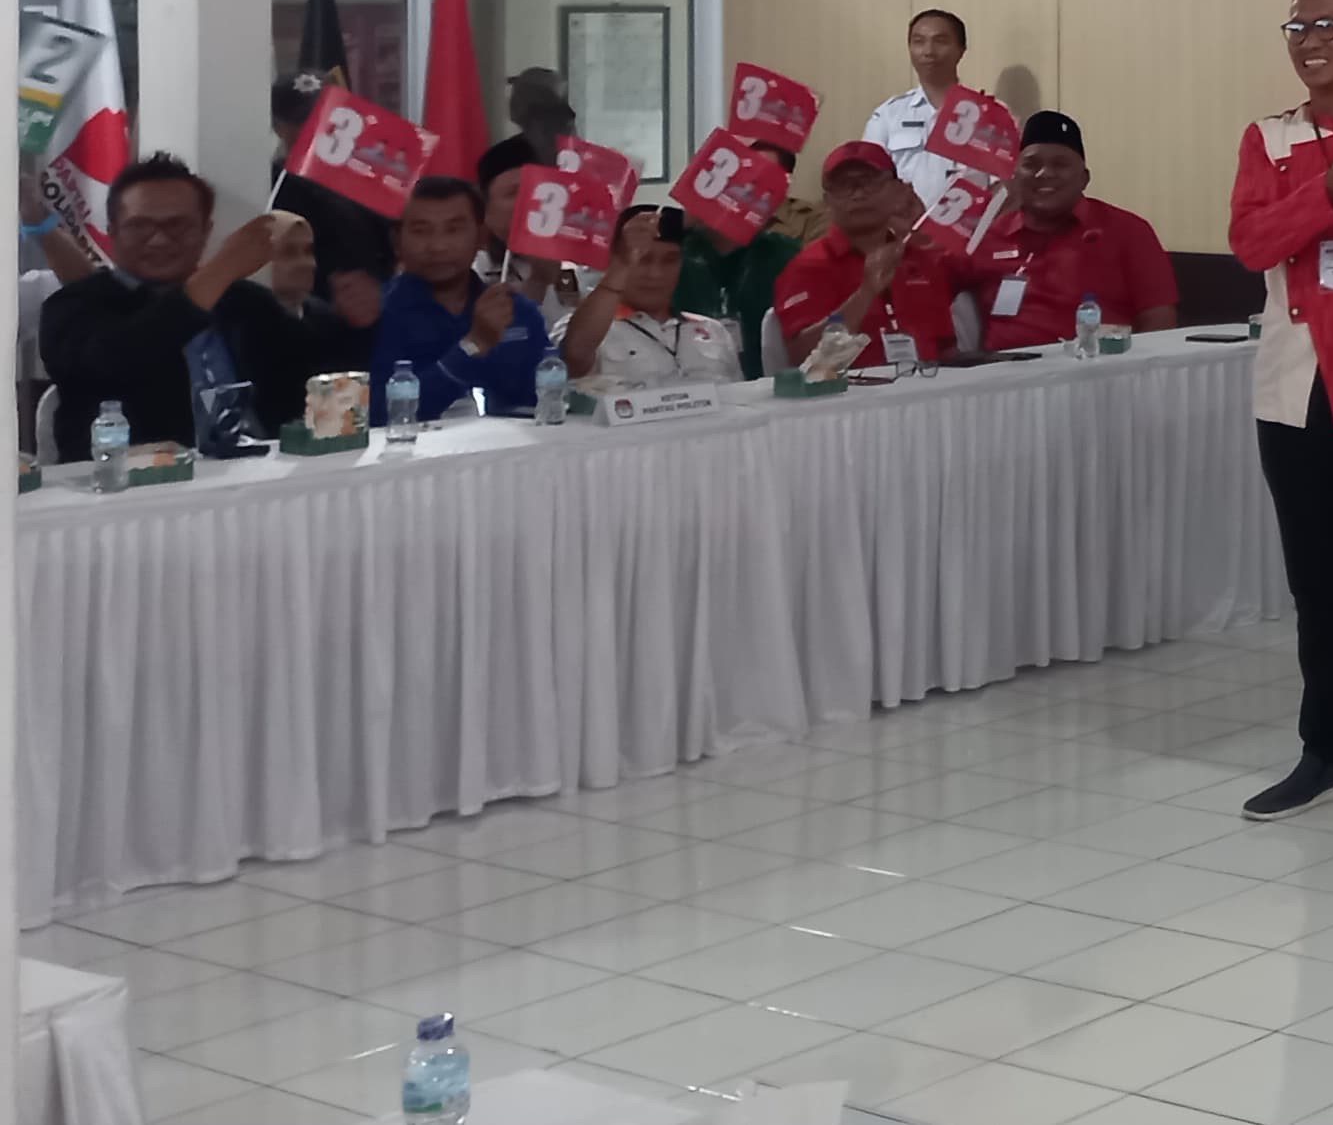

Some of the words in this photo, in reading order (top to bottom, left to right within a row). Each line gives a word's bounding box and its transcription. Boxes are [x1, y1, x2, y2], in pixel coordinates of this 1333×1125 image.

[737, 76, 768, 120] 3
[315, 107, 364, 166] 3
[944, 100, 980, 145] 3
[694, 147, 740, 199] 3
[528, 182, 569, 238] 3
[928, 188, 972, 225] 3
